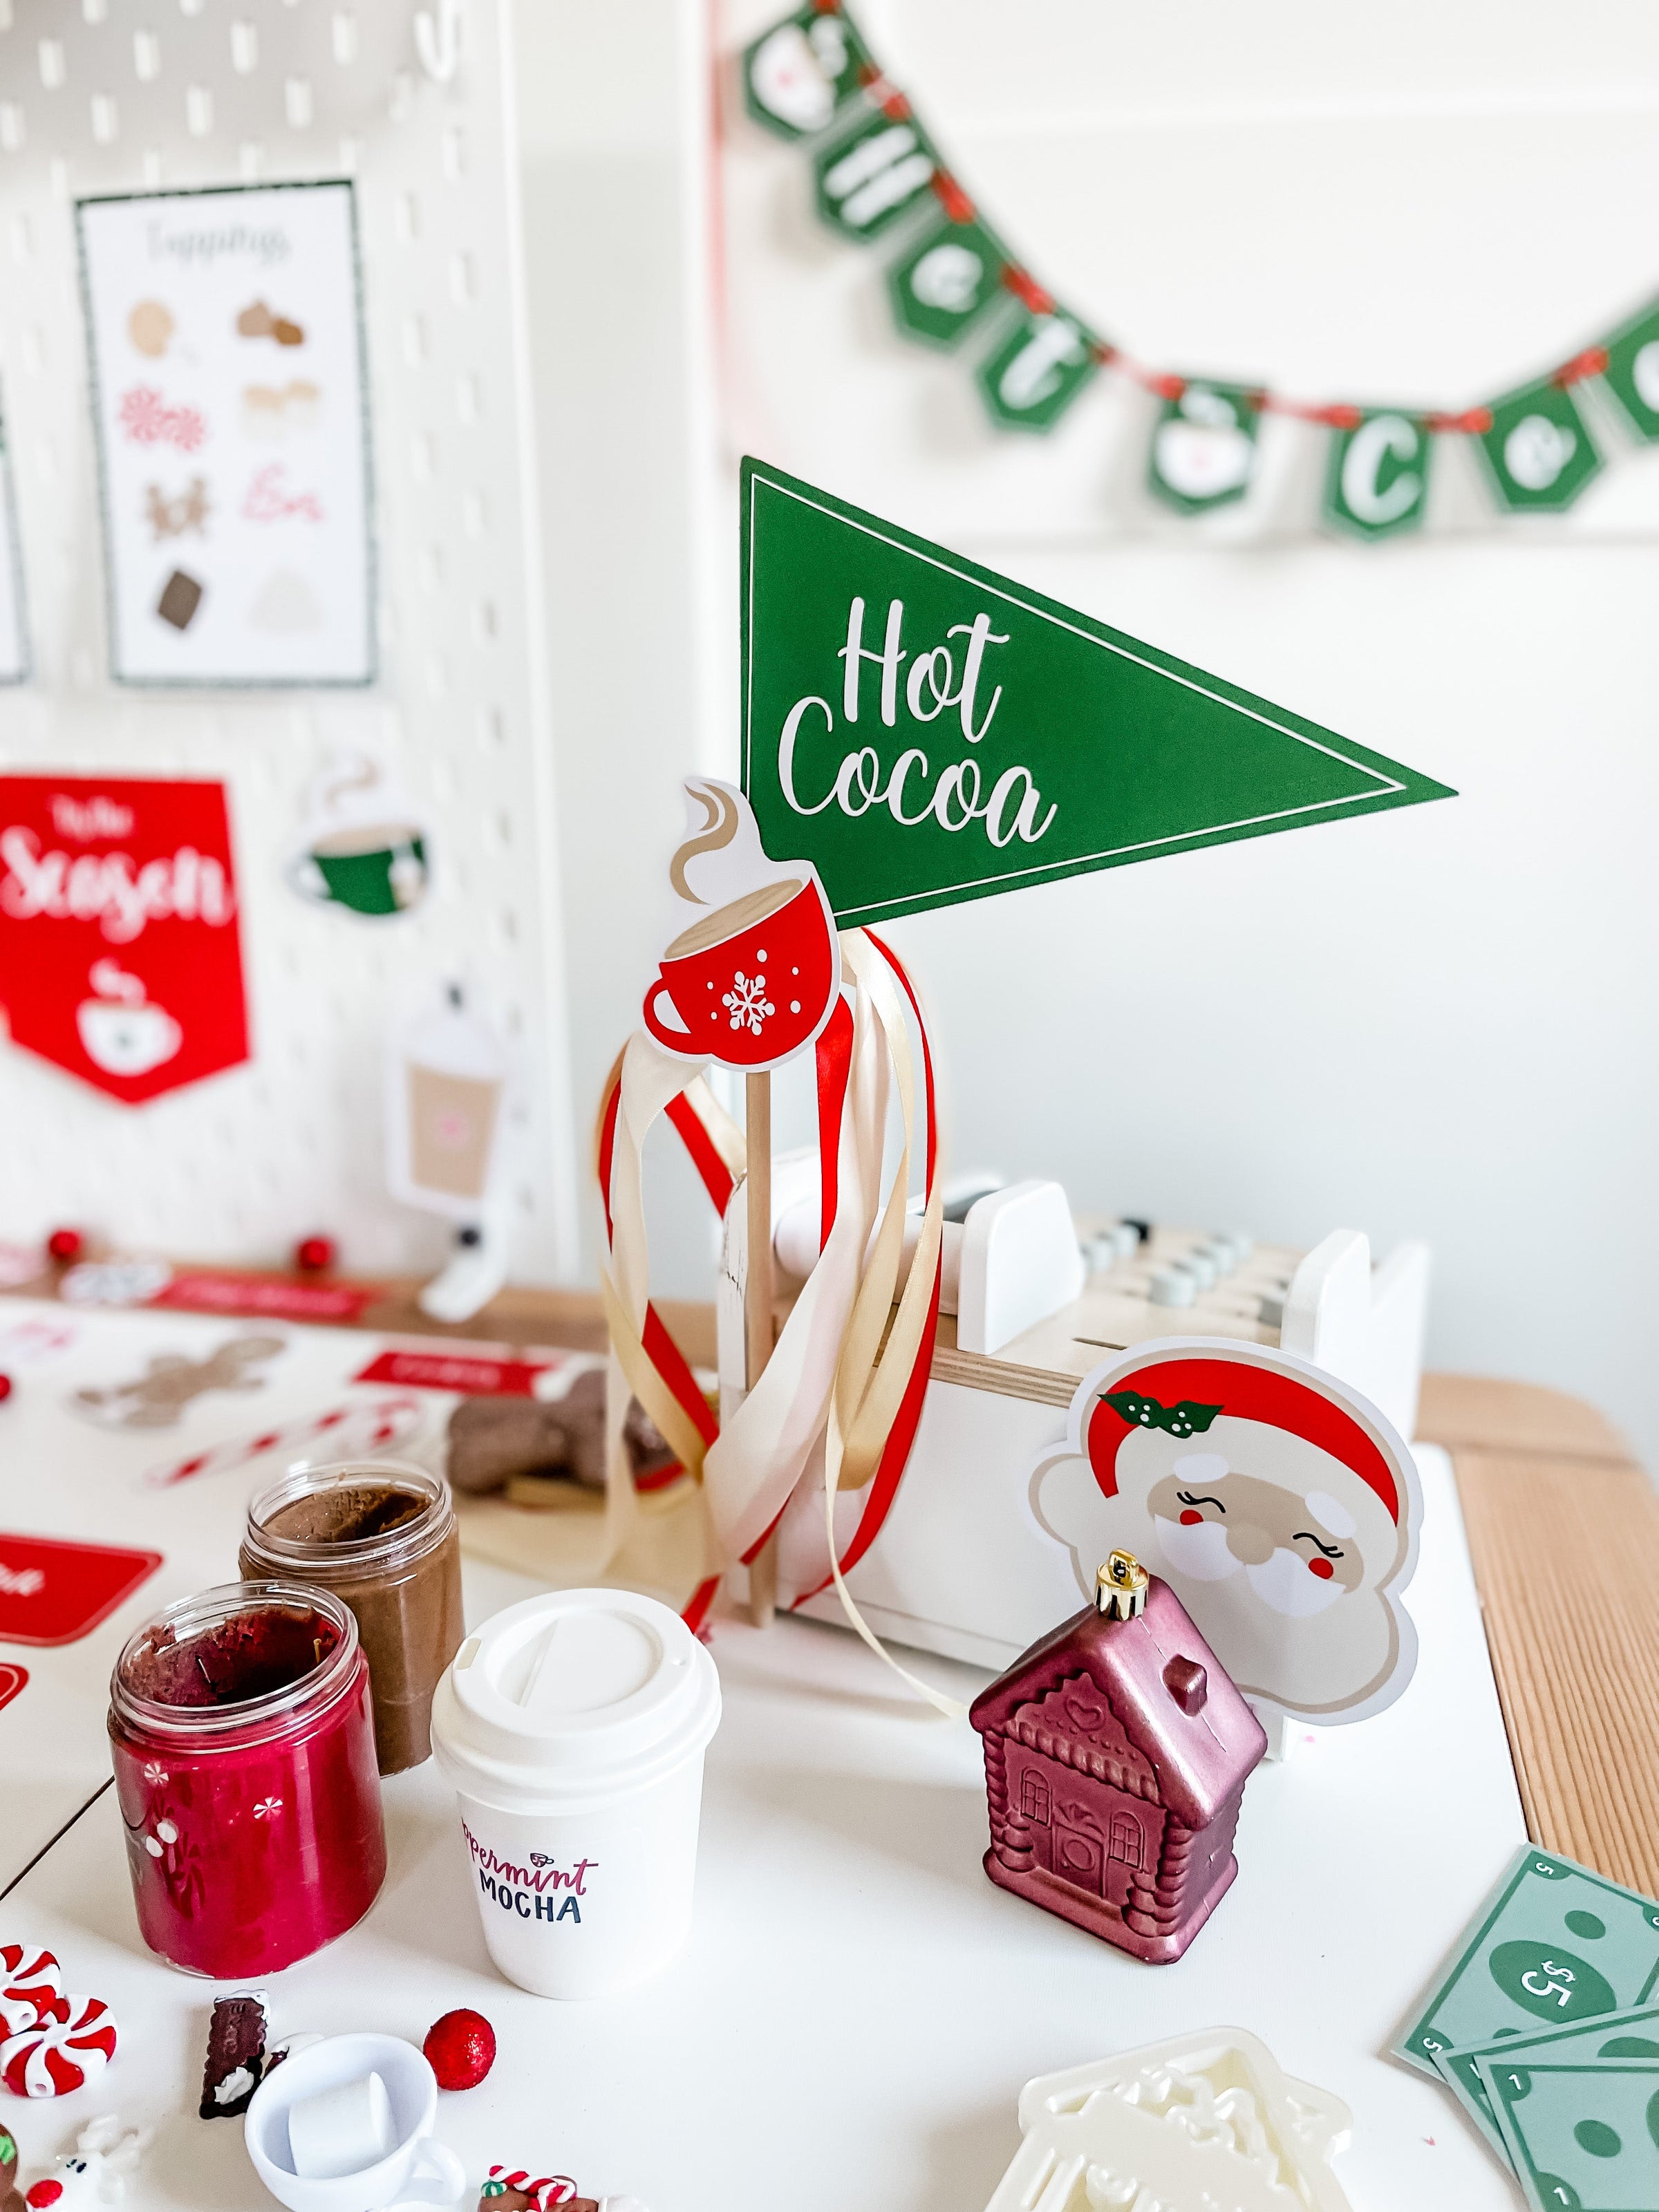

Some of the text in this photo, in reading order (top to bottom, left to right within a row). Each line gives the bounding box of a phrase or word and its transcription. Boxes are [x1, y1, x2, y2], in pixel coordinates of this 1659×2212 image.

[838, 596, 1010, 744] Hot
[778, 696, 1058, 848] Cocoa
[0, 825, 236, 945] Season
[1535, 1862, 1555, 1875] 5
[478, 1868, 581, 1924] MOCHA
[1521, 1959, 1576, 2008] $5
[1508, 2074, 1522, 2090] 1
[1553, 2186, 1570, 2206] 1
